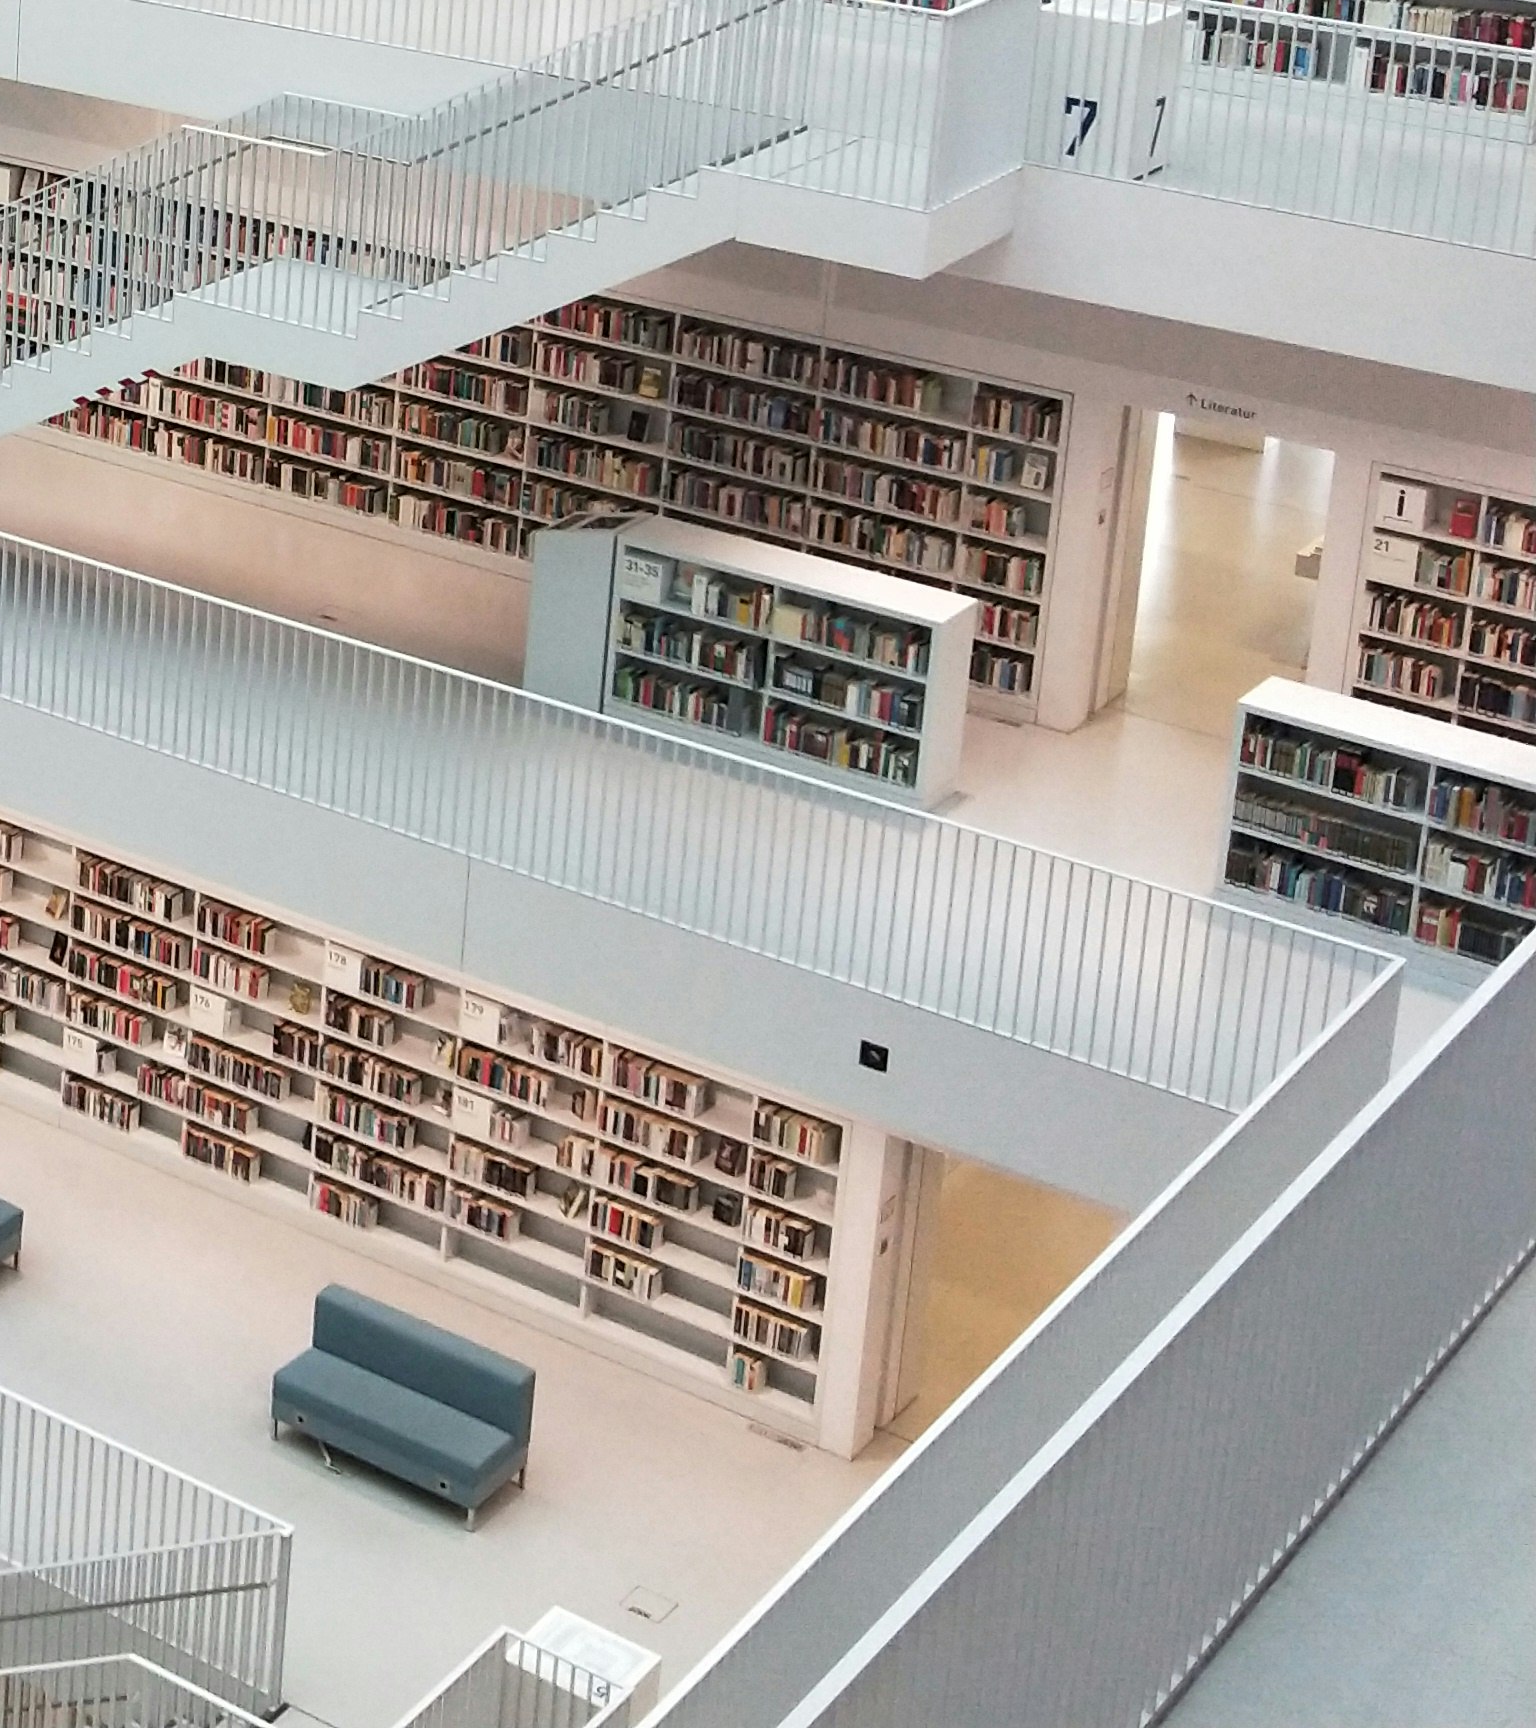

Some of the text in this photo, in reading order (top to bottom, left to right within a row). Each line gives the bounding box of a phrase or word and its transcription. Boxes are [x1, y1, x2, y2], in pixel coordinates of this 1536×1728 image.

[1065, 96, 1098, 157] 7
[1200, 397, 1258, 419] Literatur
[1374, 538, 1390, 553] 21
[625, 559, 659, 578] 31-35
[194, 994, 211, 1009] 176
[465, 1000, 484, 1015] 179
